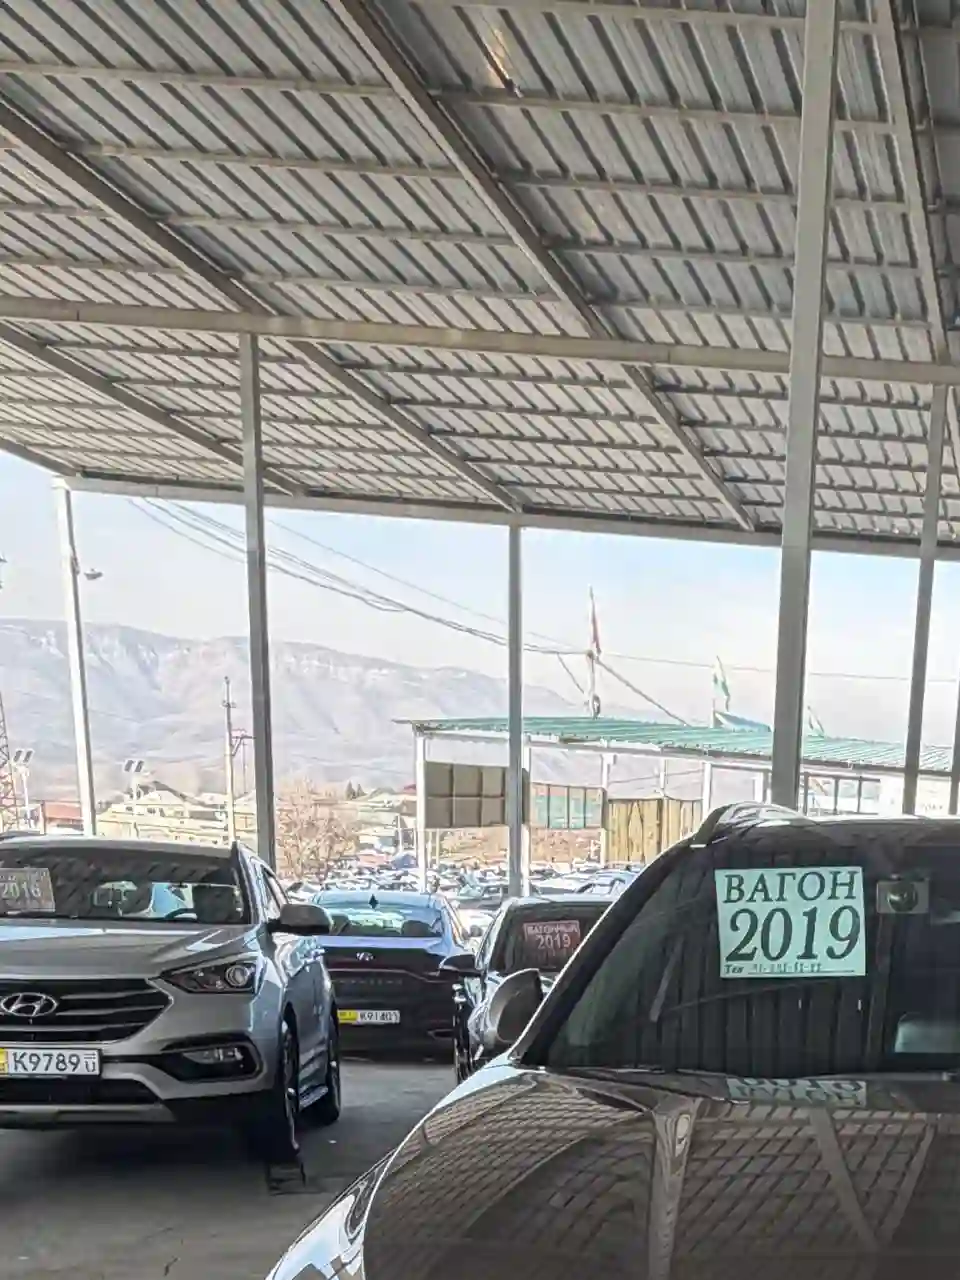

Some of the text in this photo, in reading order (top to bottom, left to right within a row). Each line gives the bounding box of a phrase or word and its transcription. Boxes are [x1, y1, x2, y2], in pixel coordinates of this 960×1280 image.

[723, 871, 859, 904] ВАГОН
[535, 932, 571, 950] 2019
[725, 904, 861, 963] 2019
